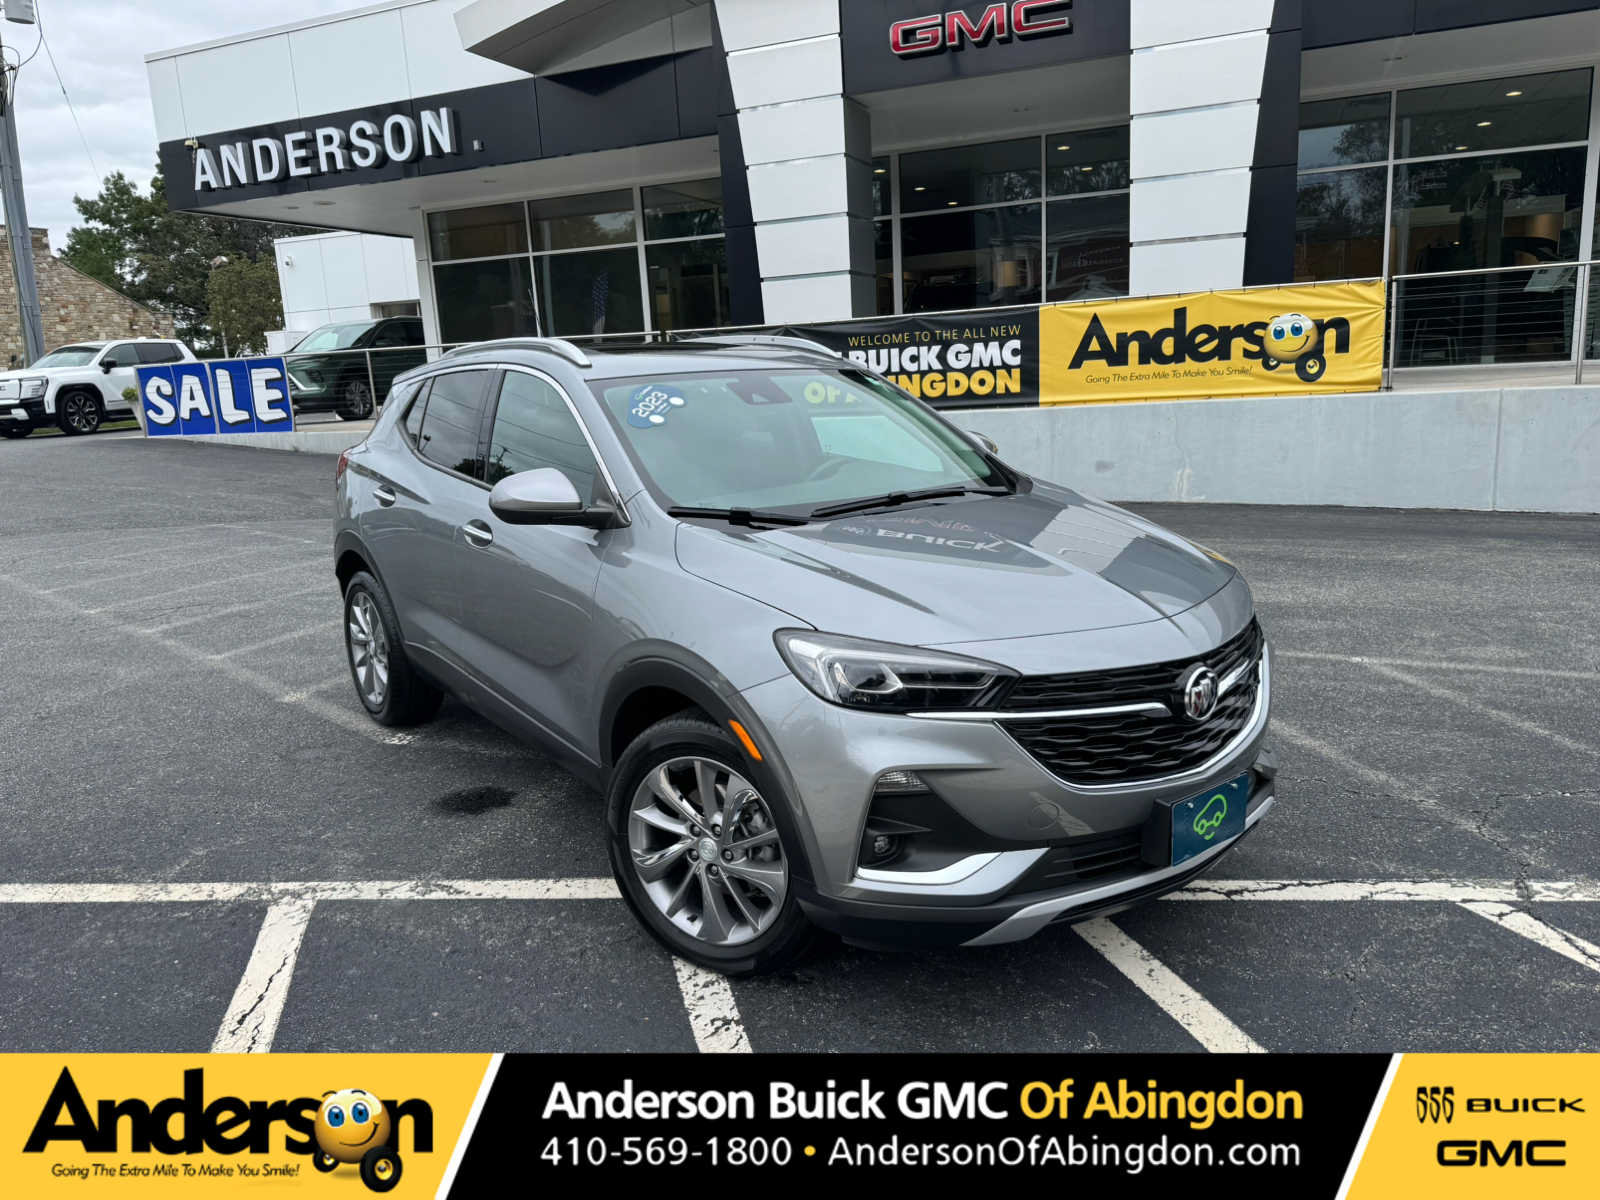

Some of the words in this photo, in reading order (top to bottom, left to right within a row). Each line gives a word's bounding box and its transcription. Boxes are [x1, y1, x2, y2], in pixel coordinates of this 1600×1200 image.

[889, 0, 1069, 54] GMC
[195, 107, 453, 191] ANDERSON
[848, 333, 910, 346] WELCOME
[914, 331, 931, 342] TO
[935, 329, 960, 341] THE
[963, 327, 986, 339] ALL
[990, 324, 1021, 337] NEW
[848, 344, 944, 374] BUICK
[946, 339, 1021, 369] GMC
[1085, 375, 1110, 384] Going
[1112, 373, 1128, 382] The
[1130, 372, 1150, 381] Extra
[1151, 371, 1170, 379] Mile
[1172, 370, 1181, 378] To
[1182, 369, 1207, 378] Make
[1209, 368, 1224, 376] You
[145, 367, 287, 425] SALE
[632, 391, 668, 417] 2023
